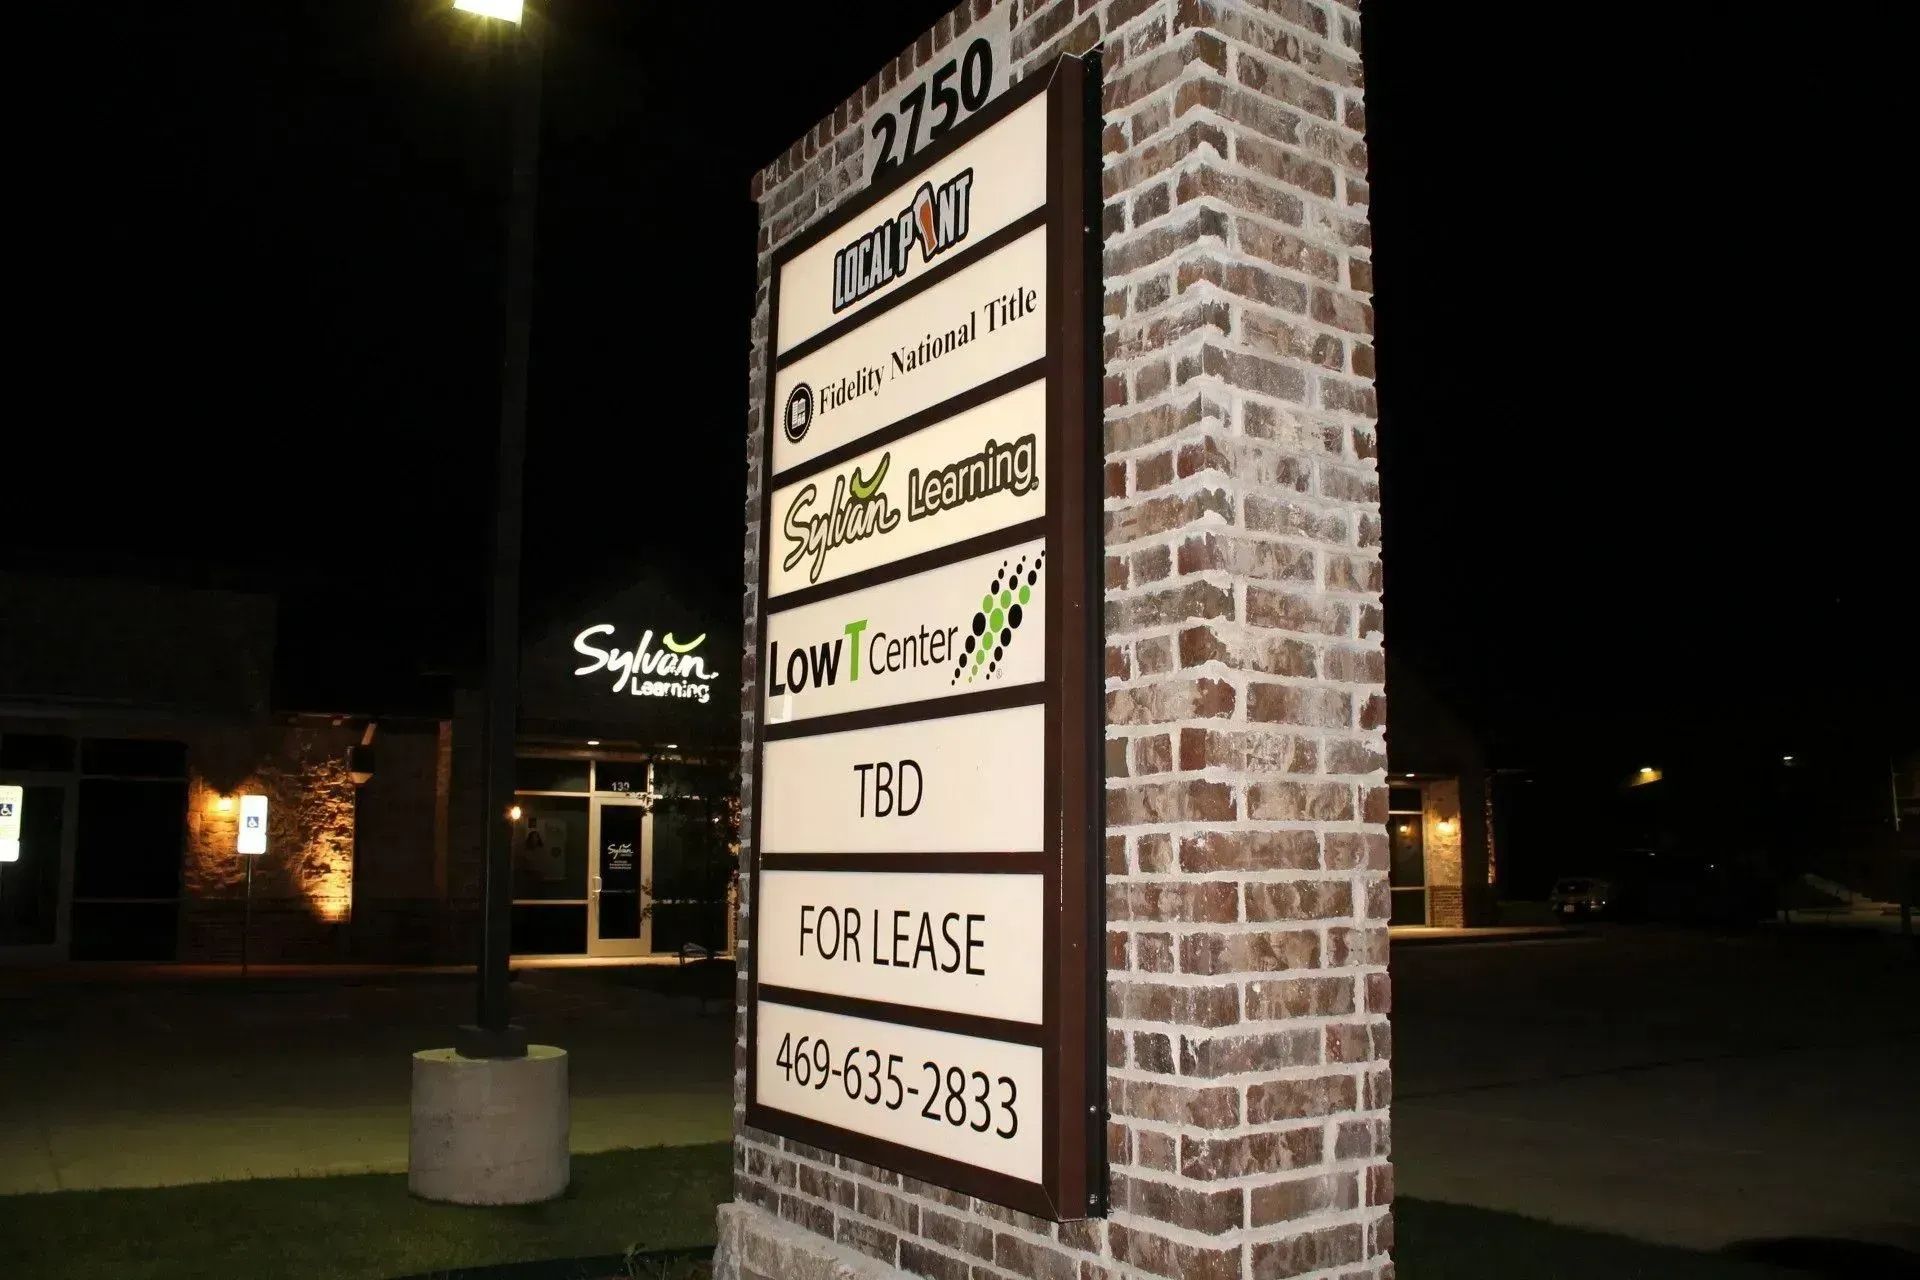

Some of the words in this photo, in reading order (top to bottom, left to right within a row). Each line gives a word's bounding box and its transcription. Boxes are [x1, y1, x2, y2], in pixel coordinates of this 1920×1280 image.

[870, 37, 993, 184] 2750
[833, 217, 895, 315] LOCAL
[819, 364, 885, 416] Fidelity
[890, 311, 976, 381] National
[984, 286, 1037, 334] Title
[783, 452, 901, 584] Sylvan
[908, 433, 1037, 522] Learning
[573, 624, 719, 693] Sylvan
[631, 676, 711, 704] Learning
[869, 624, 958, 676] Center
[853, 759, 923, 818] TBD
[799, 905, 861, 963] FOR
[873, 909, 985, 976] LEASE
[776, 1032, 1018, 1139] 469-635-2833
